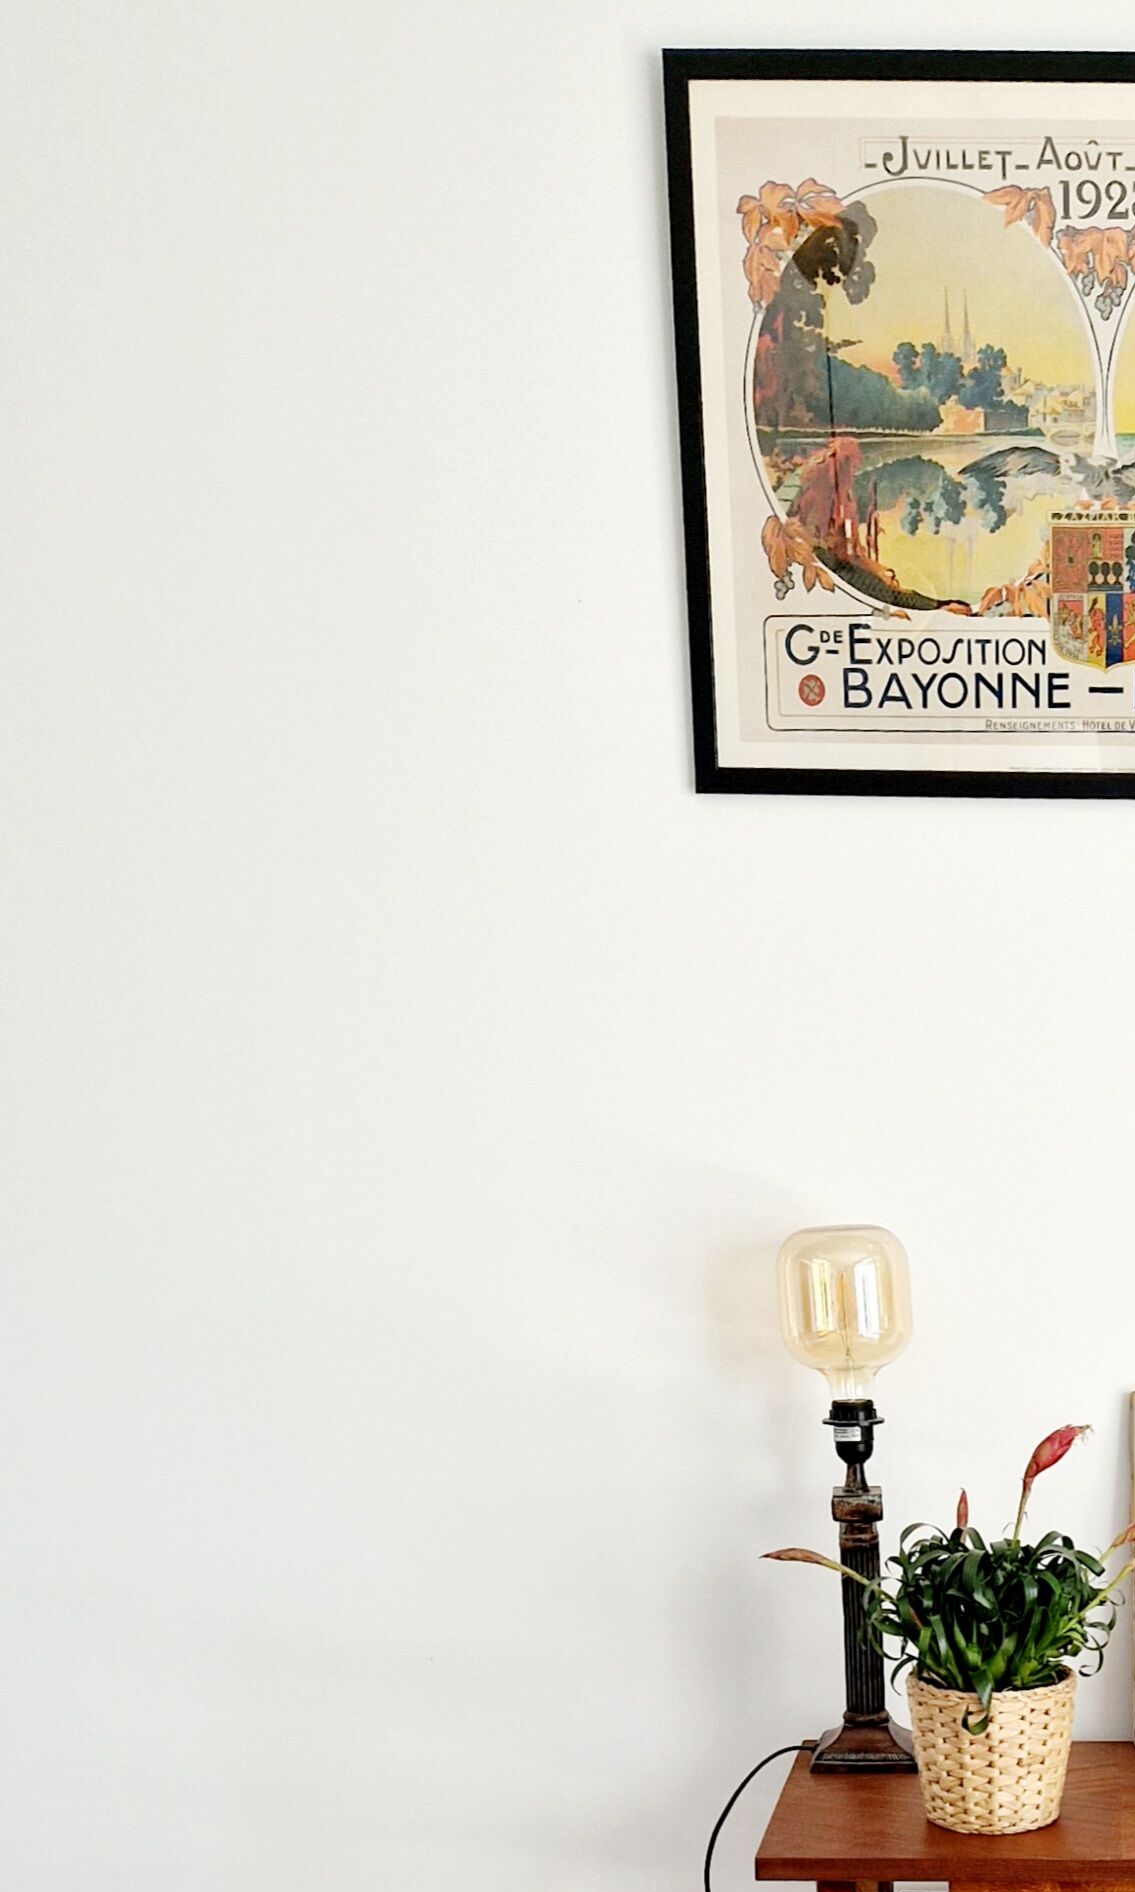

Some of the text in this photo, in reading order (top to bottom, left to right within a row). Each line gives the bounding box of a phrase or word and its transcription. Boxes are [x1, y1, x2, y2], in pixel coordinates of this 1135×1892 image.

[848, 623, 1046, 665] EXPOSITION
[843, 668, 1071, 709] BAYONNE
[985, 720, 1075, 730] RENSEIGNEMENTS
[1114, 720, 1126, 730] DE
